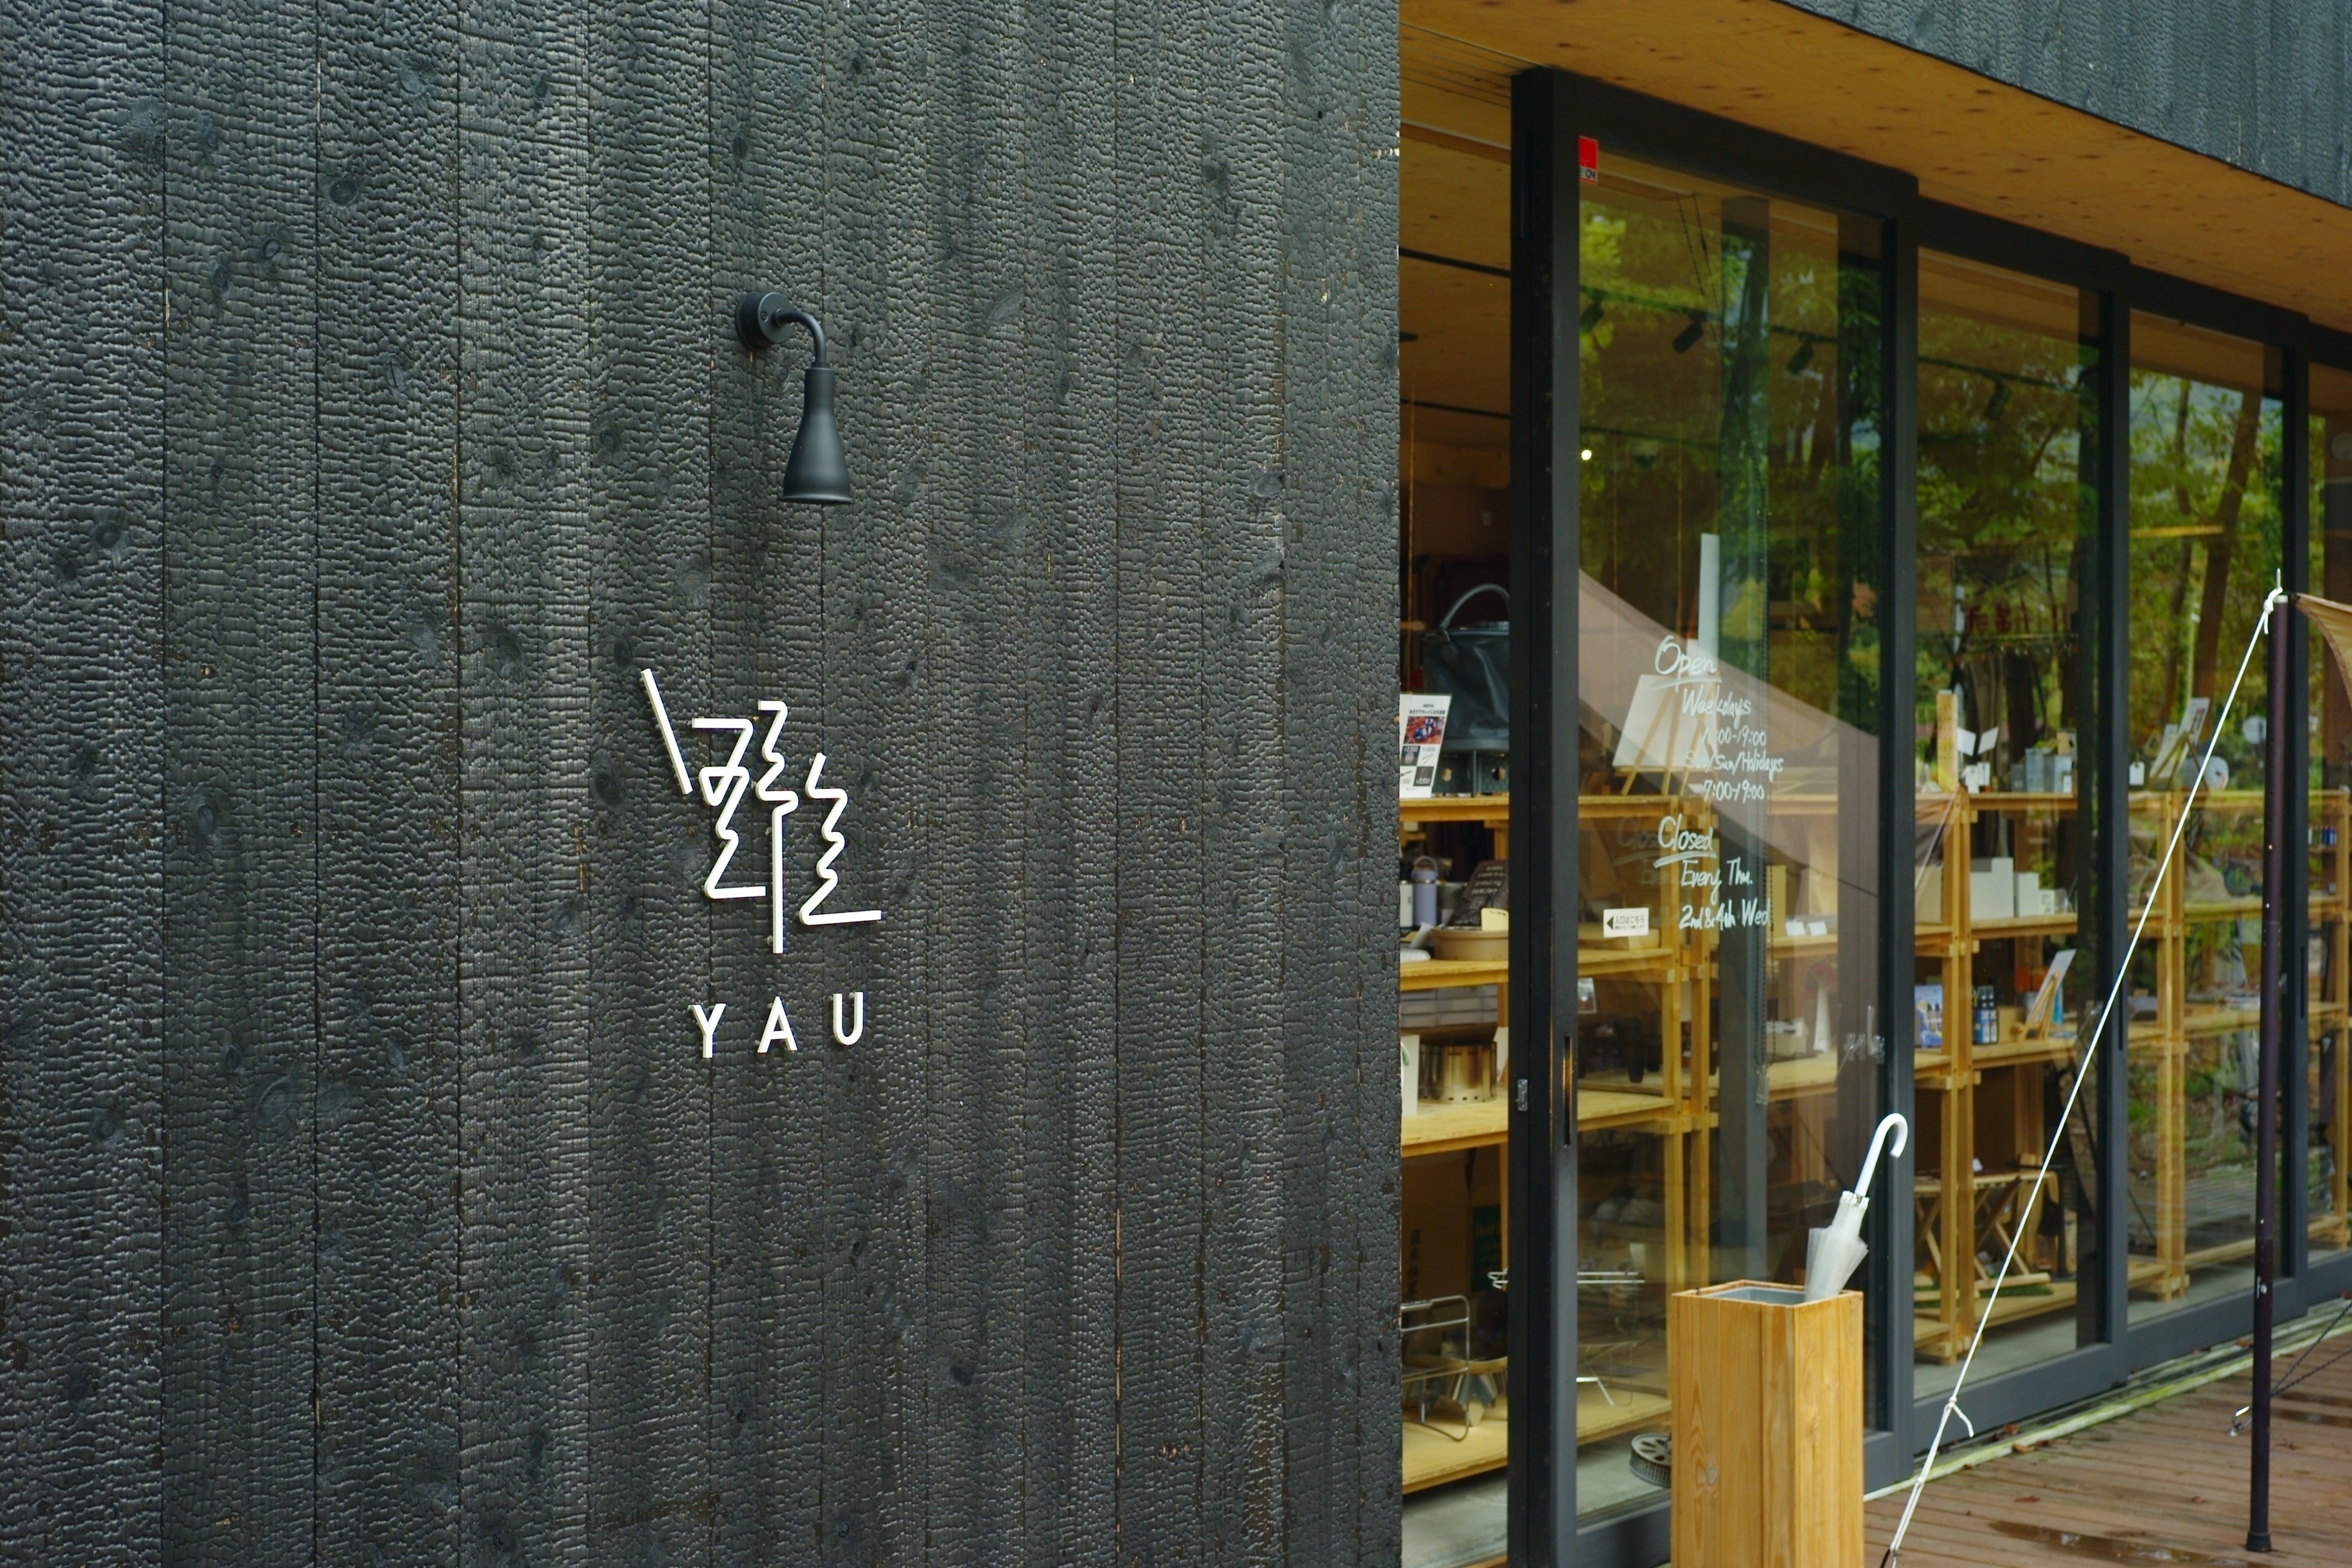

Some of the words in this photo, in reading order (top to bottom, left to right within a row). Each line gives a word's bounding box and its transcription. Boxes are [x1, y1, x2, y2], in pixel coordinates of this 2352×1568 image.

[1656, 636, 1716, 692] Open
[1683, 685, 1751, 729] Weekdays
[1703, 779, 1765, 804] 7:00-19:00
[1659, 813, 1713, 851] Closed
[1681, 860, 1722, 905] Every
[1726, 856, 1753, 886] Thu.
[1742, 897, 1771, 927] Wed
[688, 990, 865, 1059] YAU
